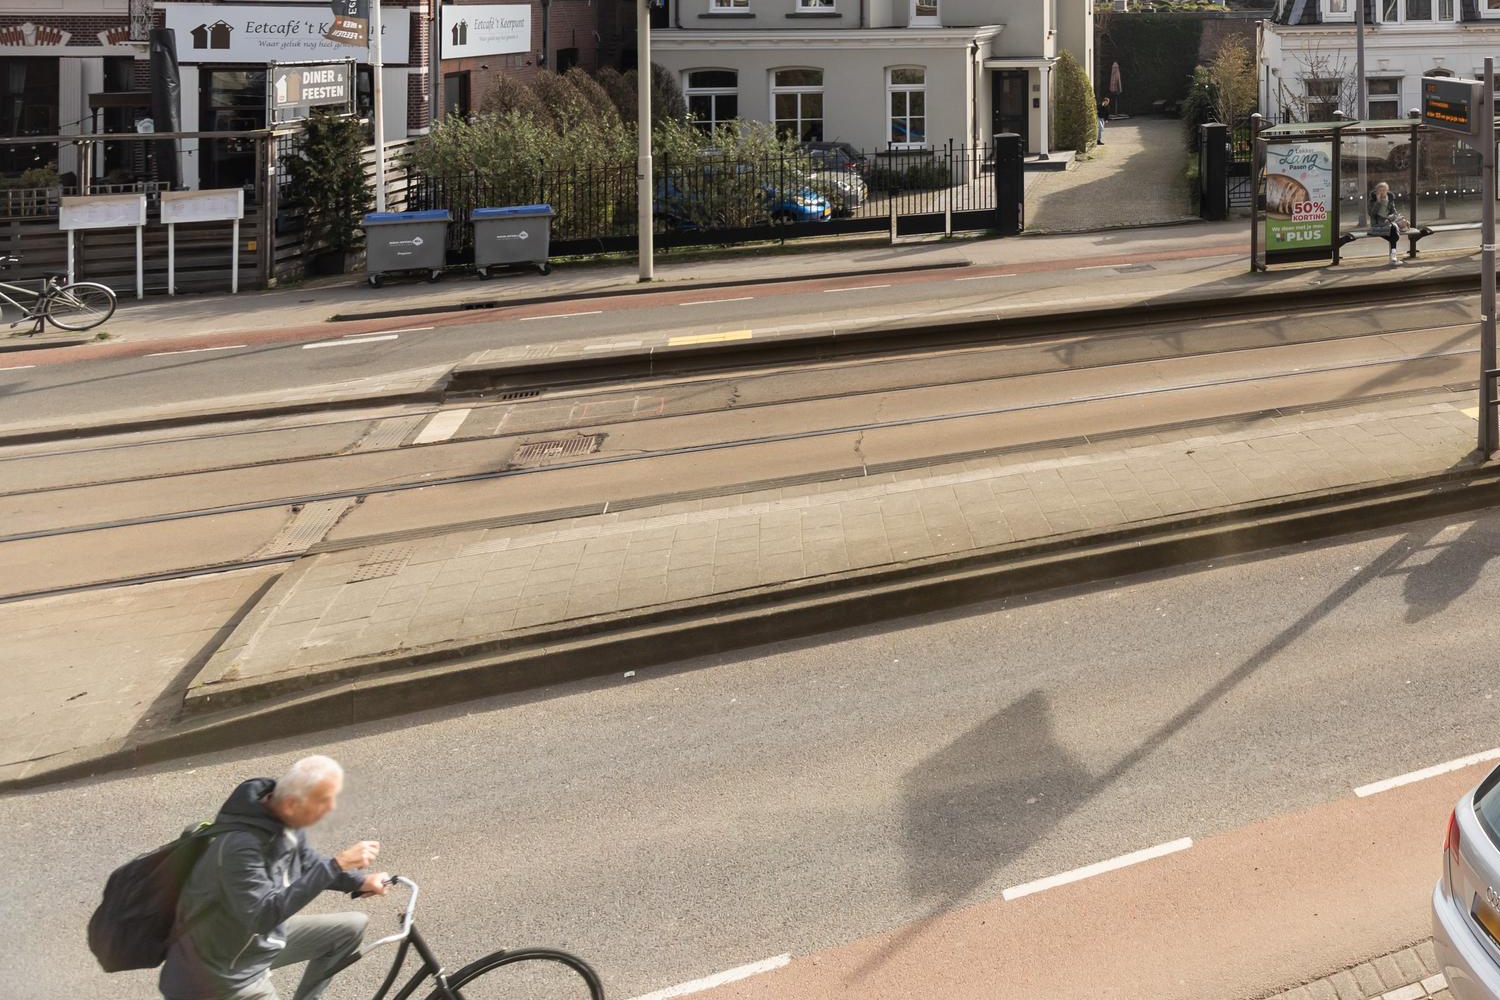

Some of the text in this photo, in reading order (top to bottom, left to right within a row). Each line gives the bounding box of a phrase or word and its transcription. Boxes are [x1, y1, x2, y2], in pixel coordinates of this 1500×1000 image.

[245, 20, 300, 37] Eetcafé
[258, 40, 279, 48] Waar
[280, 40, 301, 50] geluk
[303, 69, 343, 85] DINER &
[302, 85, 344, 100] FEESTEN
[1294, 201, 1325, 214] 50%
[1293, 213, 1326, 221] KORTING
[1286, 230, 1321, 242] PLUS
